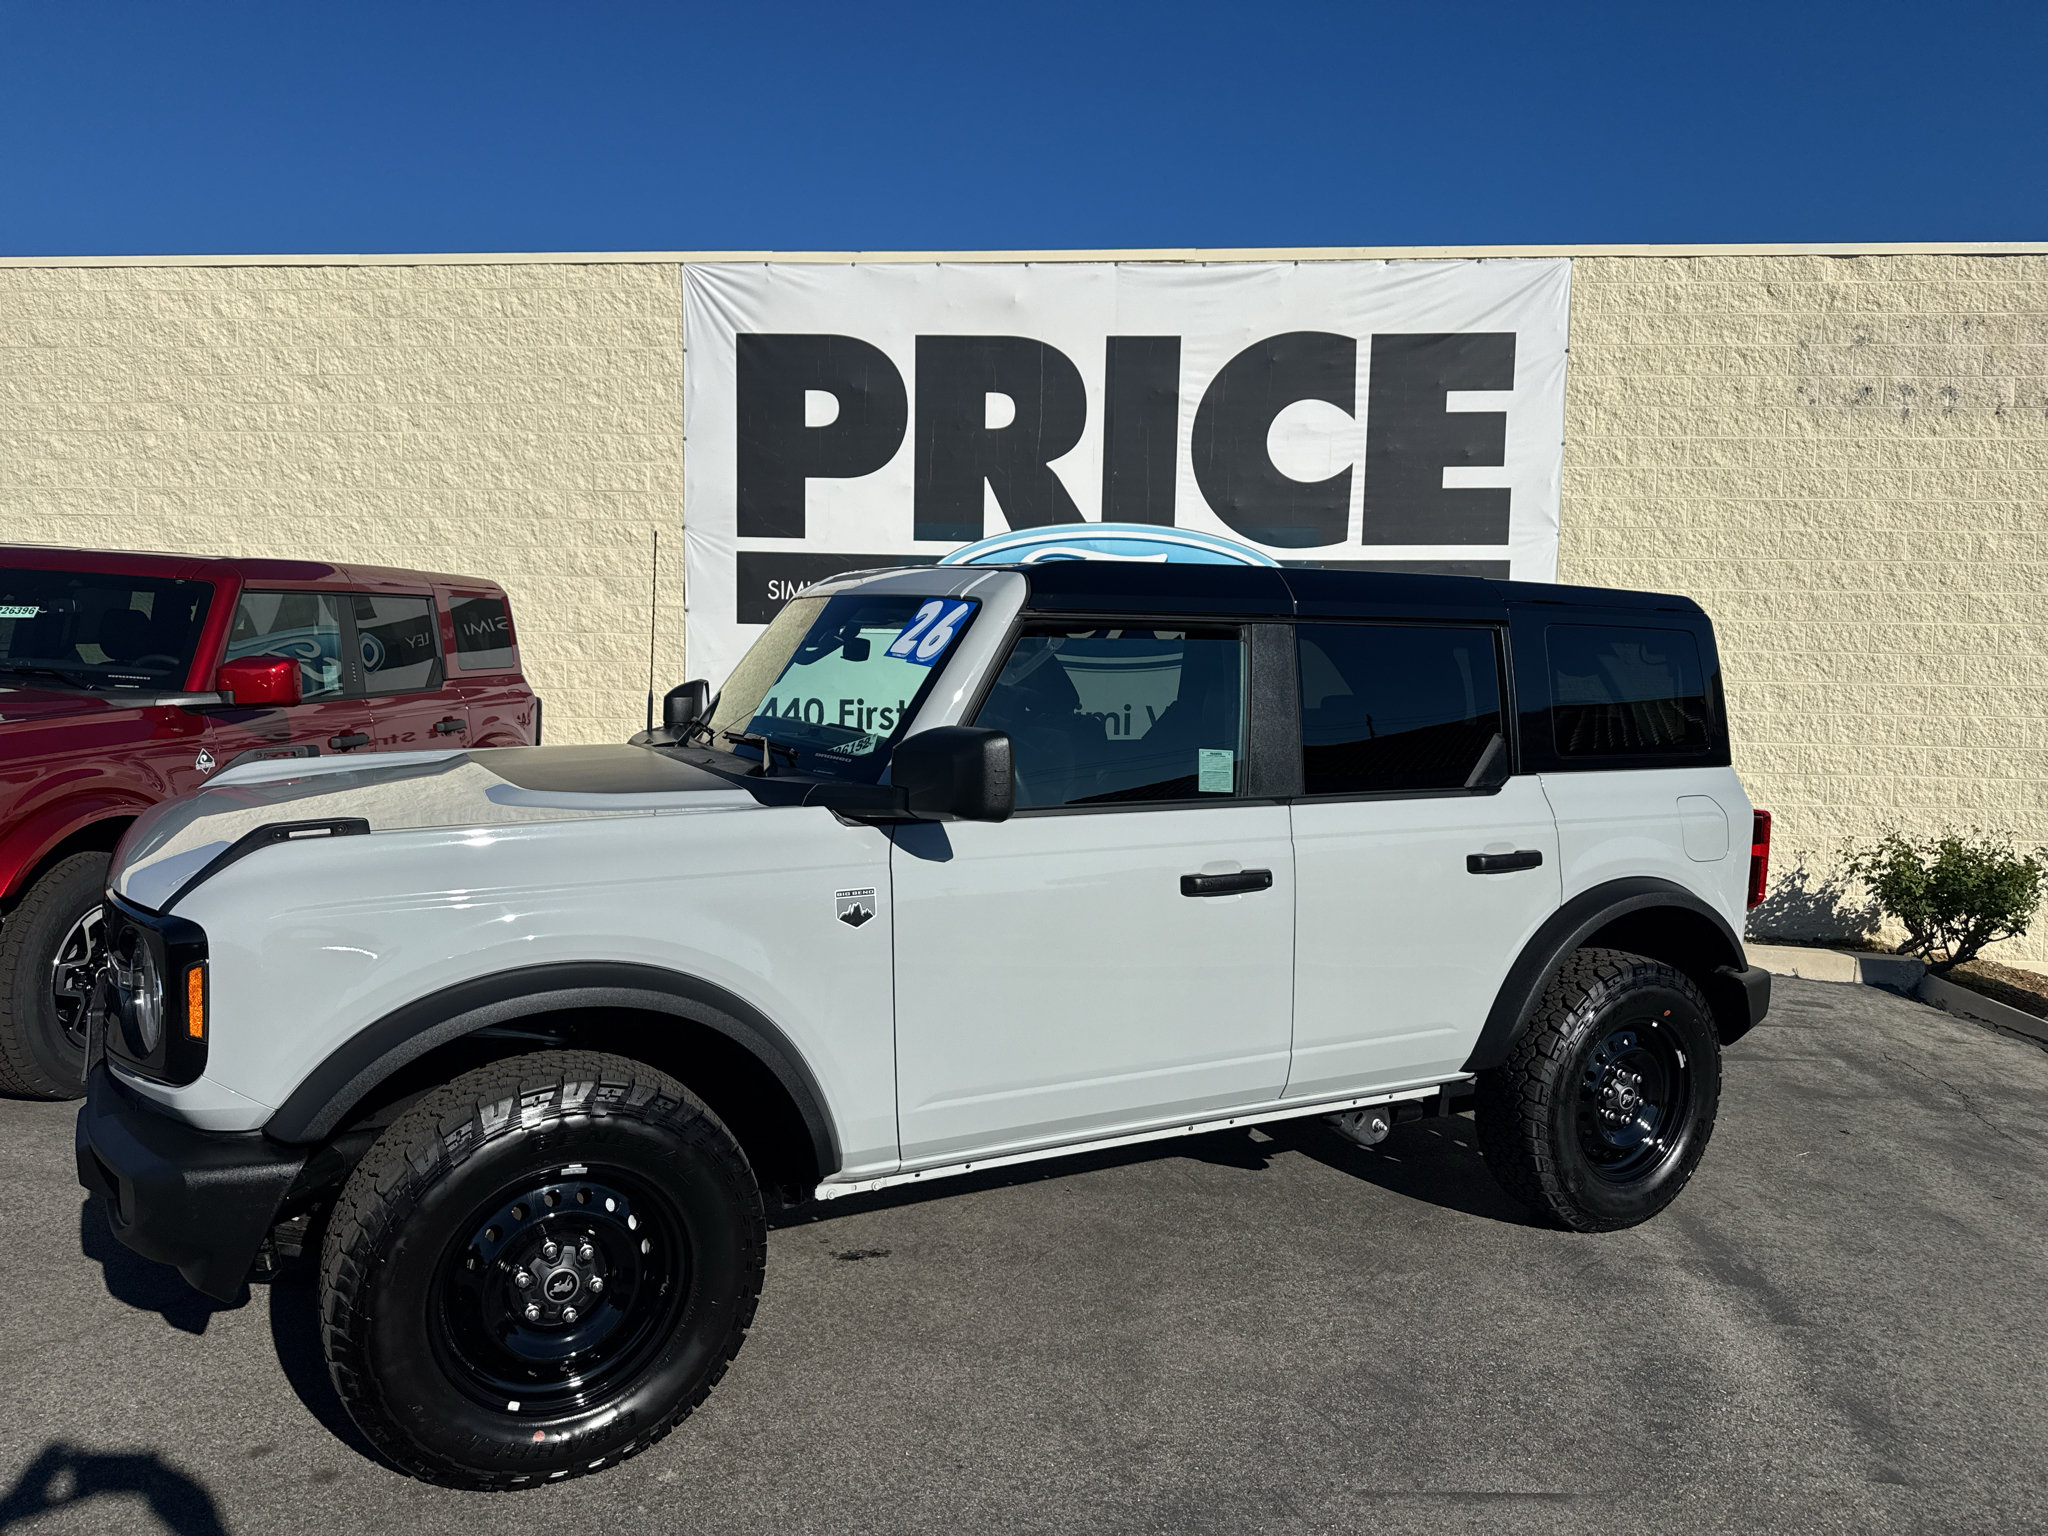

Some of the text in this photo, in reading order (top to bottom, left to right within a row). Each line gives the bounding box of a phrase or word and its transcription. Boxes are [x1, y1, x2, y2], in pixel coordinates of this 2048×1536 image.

[736, 330, 1517, 549] PRICE
[767, 580, 811, 600] SIM
[889, 600, 969, 661] 26
